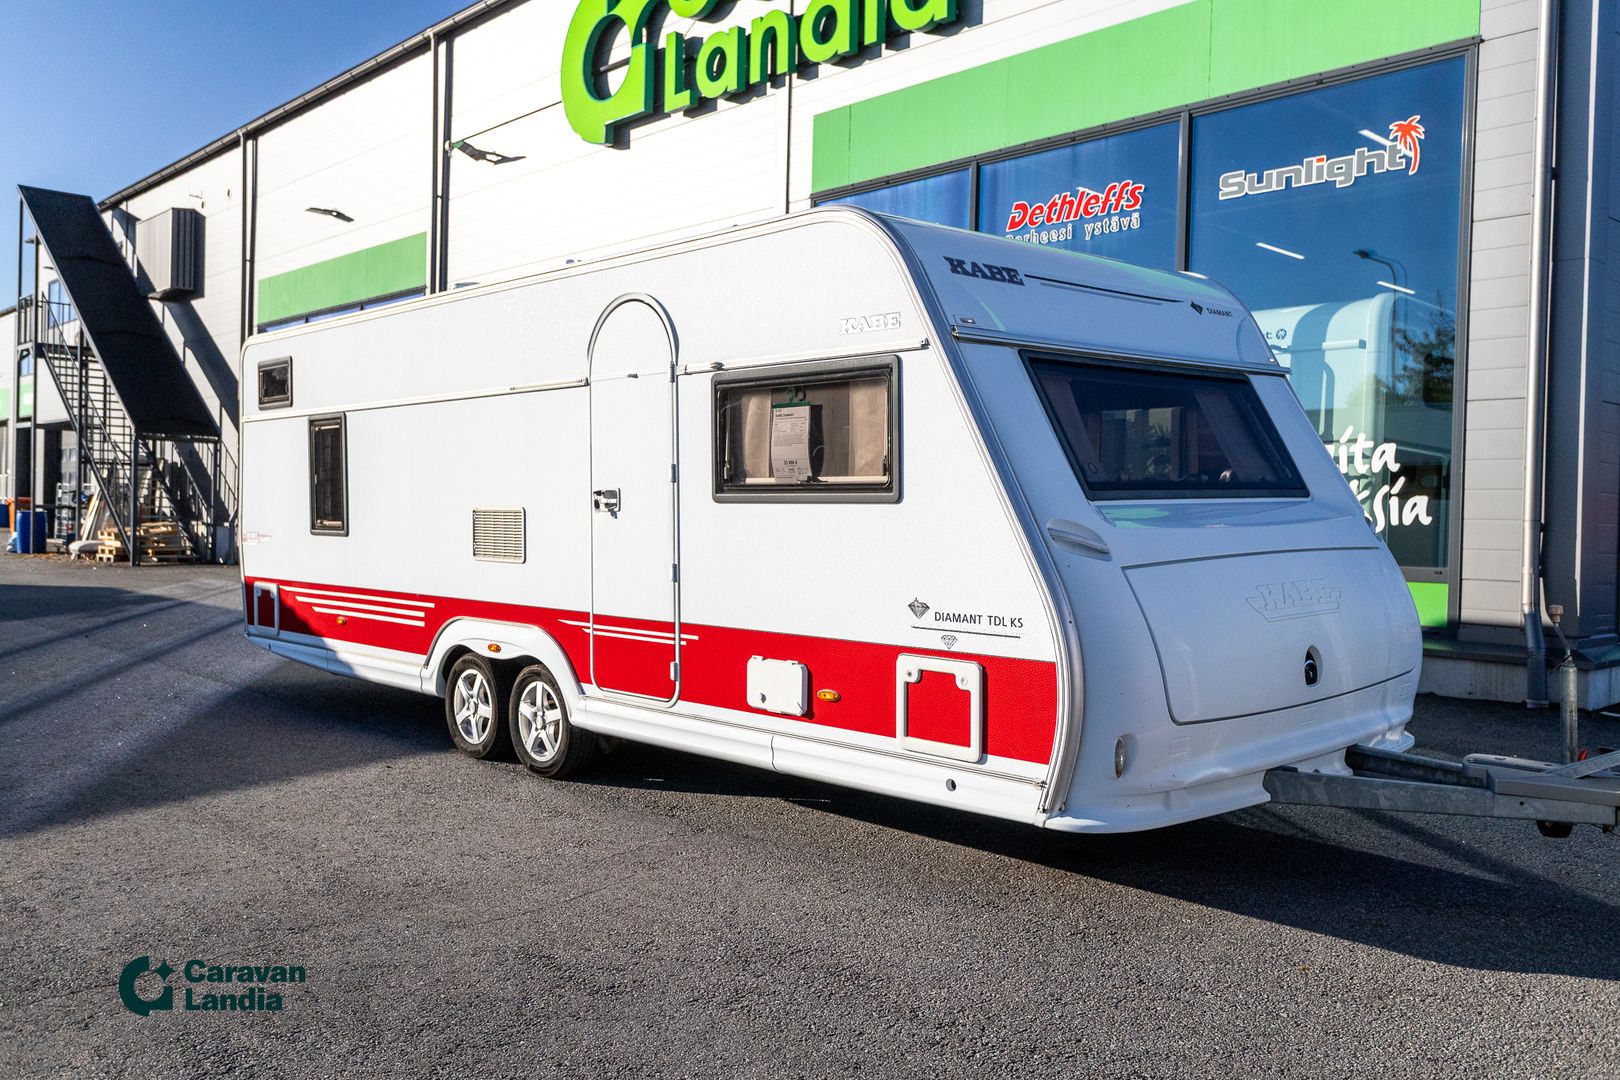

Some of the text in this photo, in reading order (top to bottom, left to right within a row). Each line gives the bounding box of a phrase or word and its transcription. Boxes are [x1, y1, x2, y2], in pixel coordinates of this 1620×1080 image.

[1219, 142, 1405, 200] Sunlight
[1006, 180, 1145, 232] Dethleffs
[1005, 211, 1141, 244] rheesi ystävä
[943, 256, 1025, 286] KABE
[839, 311, 901, 336] KABE
[1206, 307, 1233, 318] DIAMANT
[1255, 578, 1342, 612] KABE
[934, 611, 1024, 628] DIAMANT TDL KS
